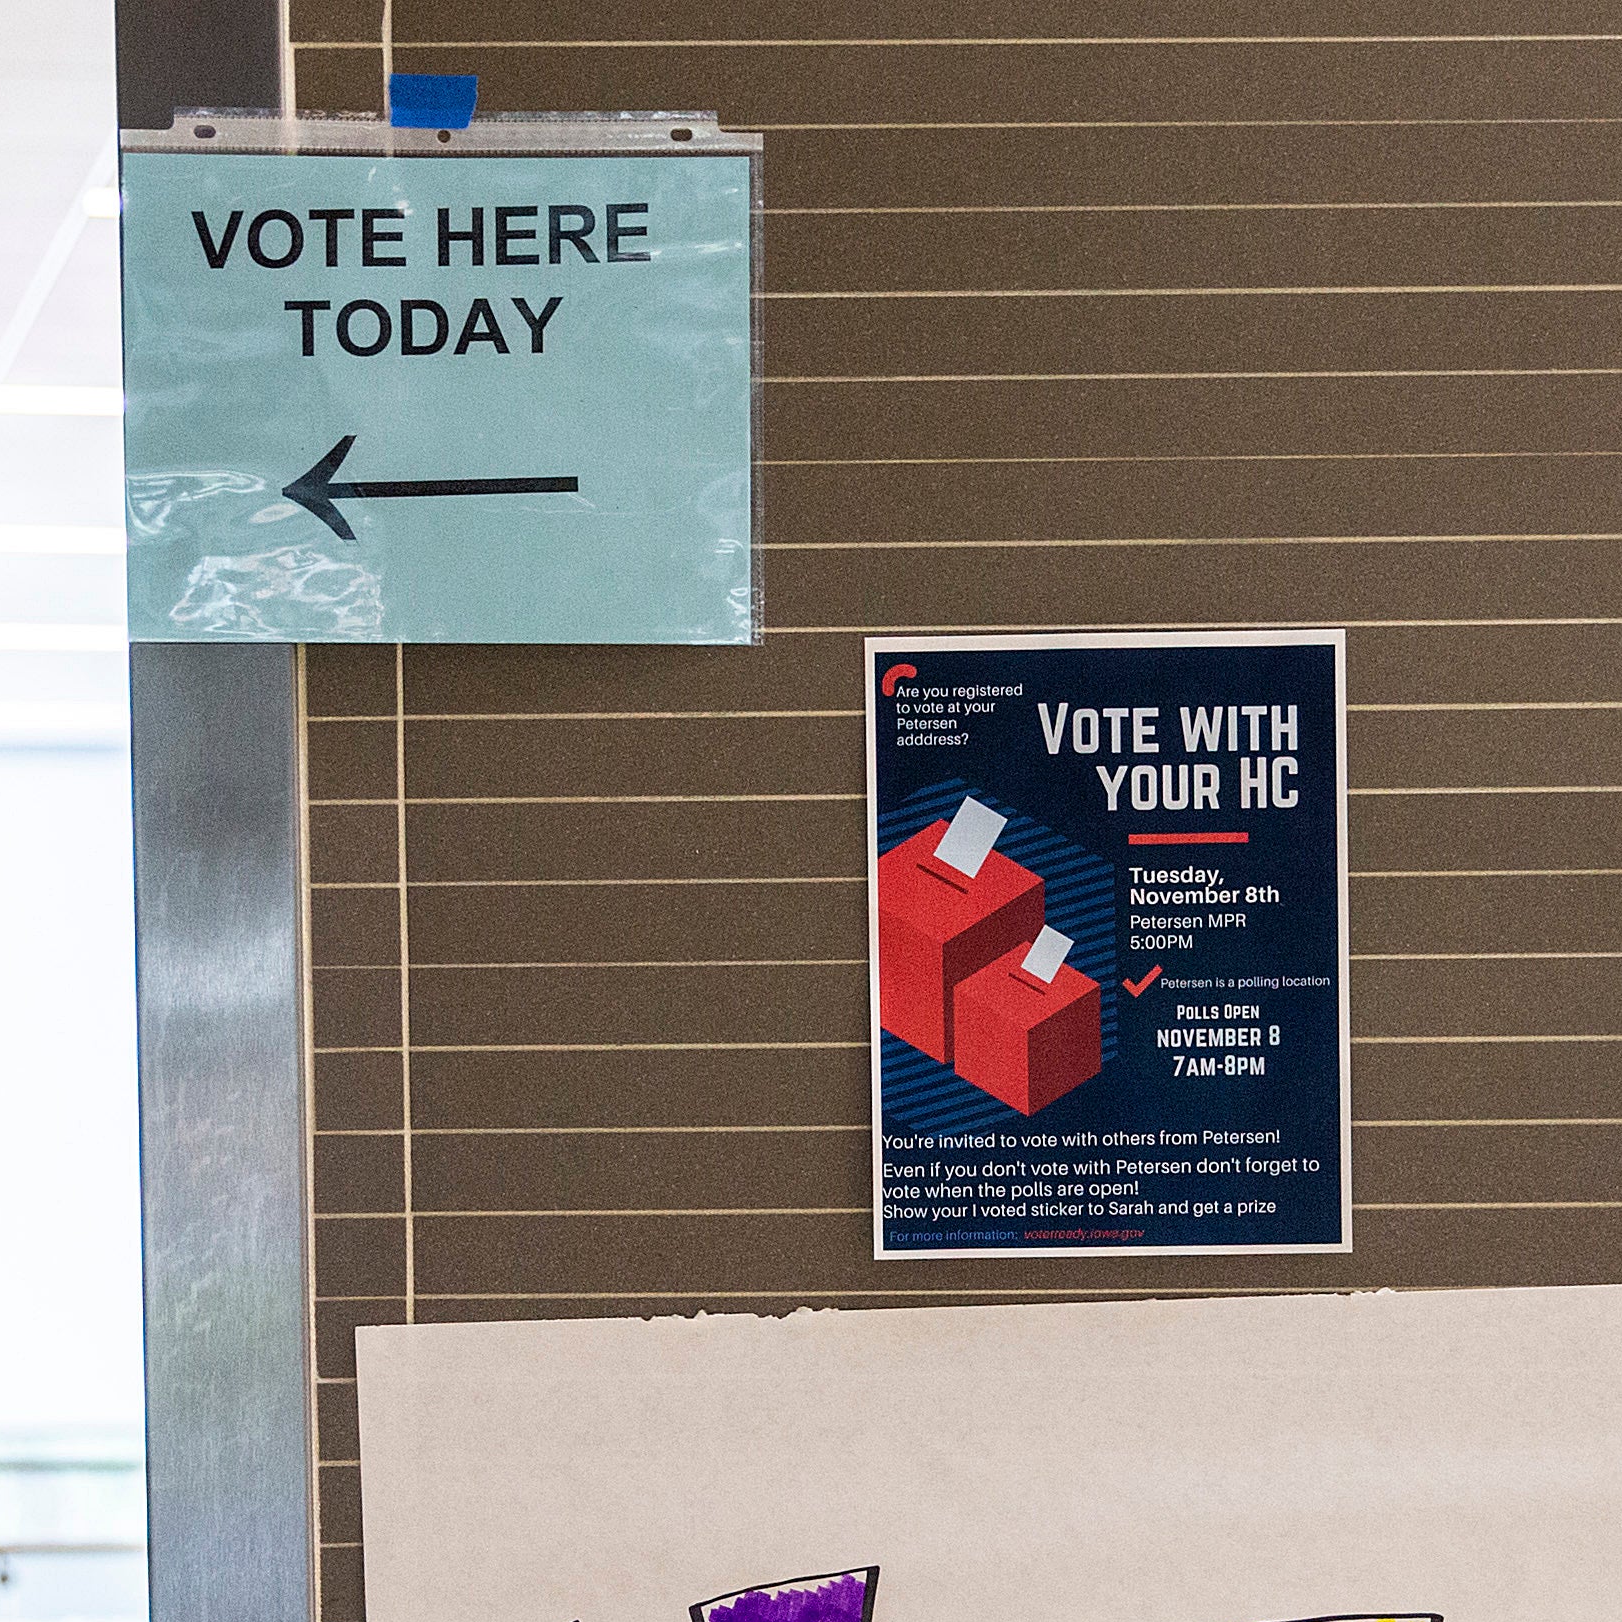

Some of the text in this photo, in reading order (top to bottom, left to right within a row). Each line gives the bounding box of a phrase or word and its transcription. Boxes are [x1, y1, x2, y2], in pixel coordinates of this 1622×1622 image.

[191, 202, 652, 270] VOTE HERE
[283, 296, 564, 357] TODAY
[896, 683, 1023, 700] Are you registered
[896, 702, 996, 716] to vote at your
[897, 718, 957, 730] Petersen
[896, 733, 969, 746] adddress?
[1240, 756, 1299, 809] HC
[1129, 866, 1225, 887] Tuesday,
[1130, 885, 1280, 905] November 8th
[1130, 913, 1247, 930] Petersen MPR
[1130, 935, 1193, 950] 5:00PM
[1160, 976, 1330, 990] Petersen is a polling location
[1157, 1025, 1281, 1048] NOVEMBER 8
[1173, 1056, 1265, 1077] 7AM-8PM
[882, 1129, 1280, 1149] You're invited to vote with others from Petersen!
[883, 1157, 1320, 1181] Even if you don't vote with Petersen don't forget to
[883, 1181, 1139, 1200] vote when the polls are open!
[883, 1204, 927, 1219] Show
[932, 1206, 968, 1221] your
[981, 1203, 1026, 1217] voted
[1031, 1202, 1084, 1216] sticker
[1088, 1202, 1103, 1216] to
[1108, 1200, 1154, 1215] Sarah
[1158, 1200, 1189, 1215] and
[1193, 1200, 1219, 1217] get
[1223, 1203, 1233, 1214] a
[1237, 1200, 1277, 1217] prize
[890, 1231, 909, 1242] For
[913, 1232, 943, 1242] more
[946, 1229, 1018, 1241] information:
